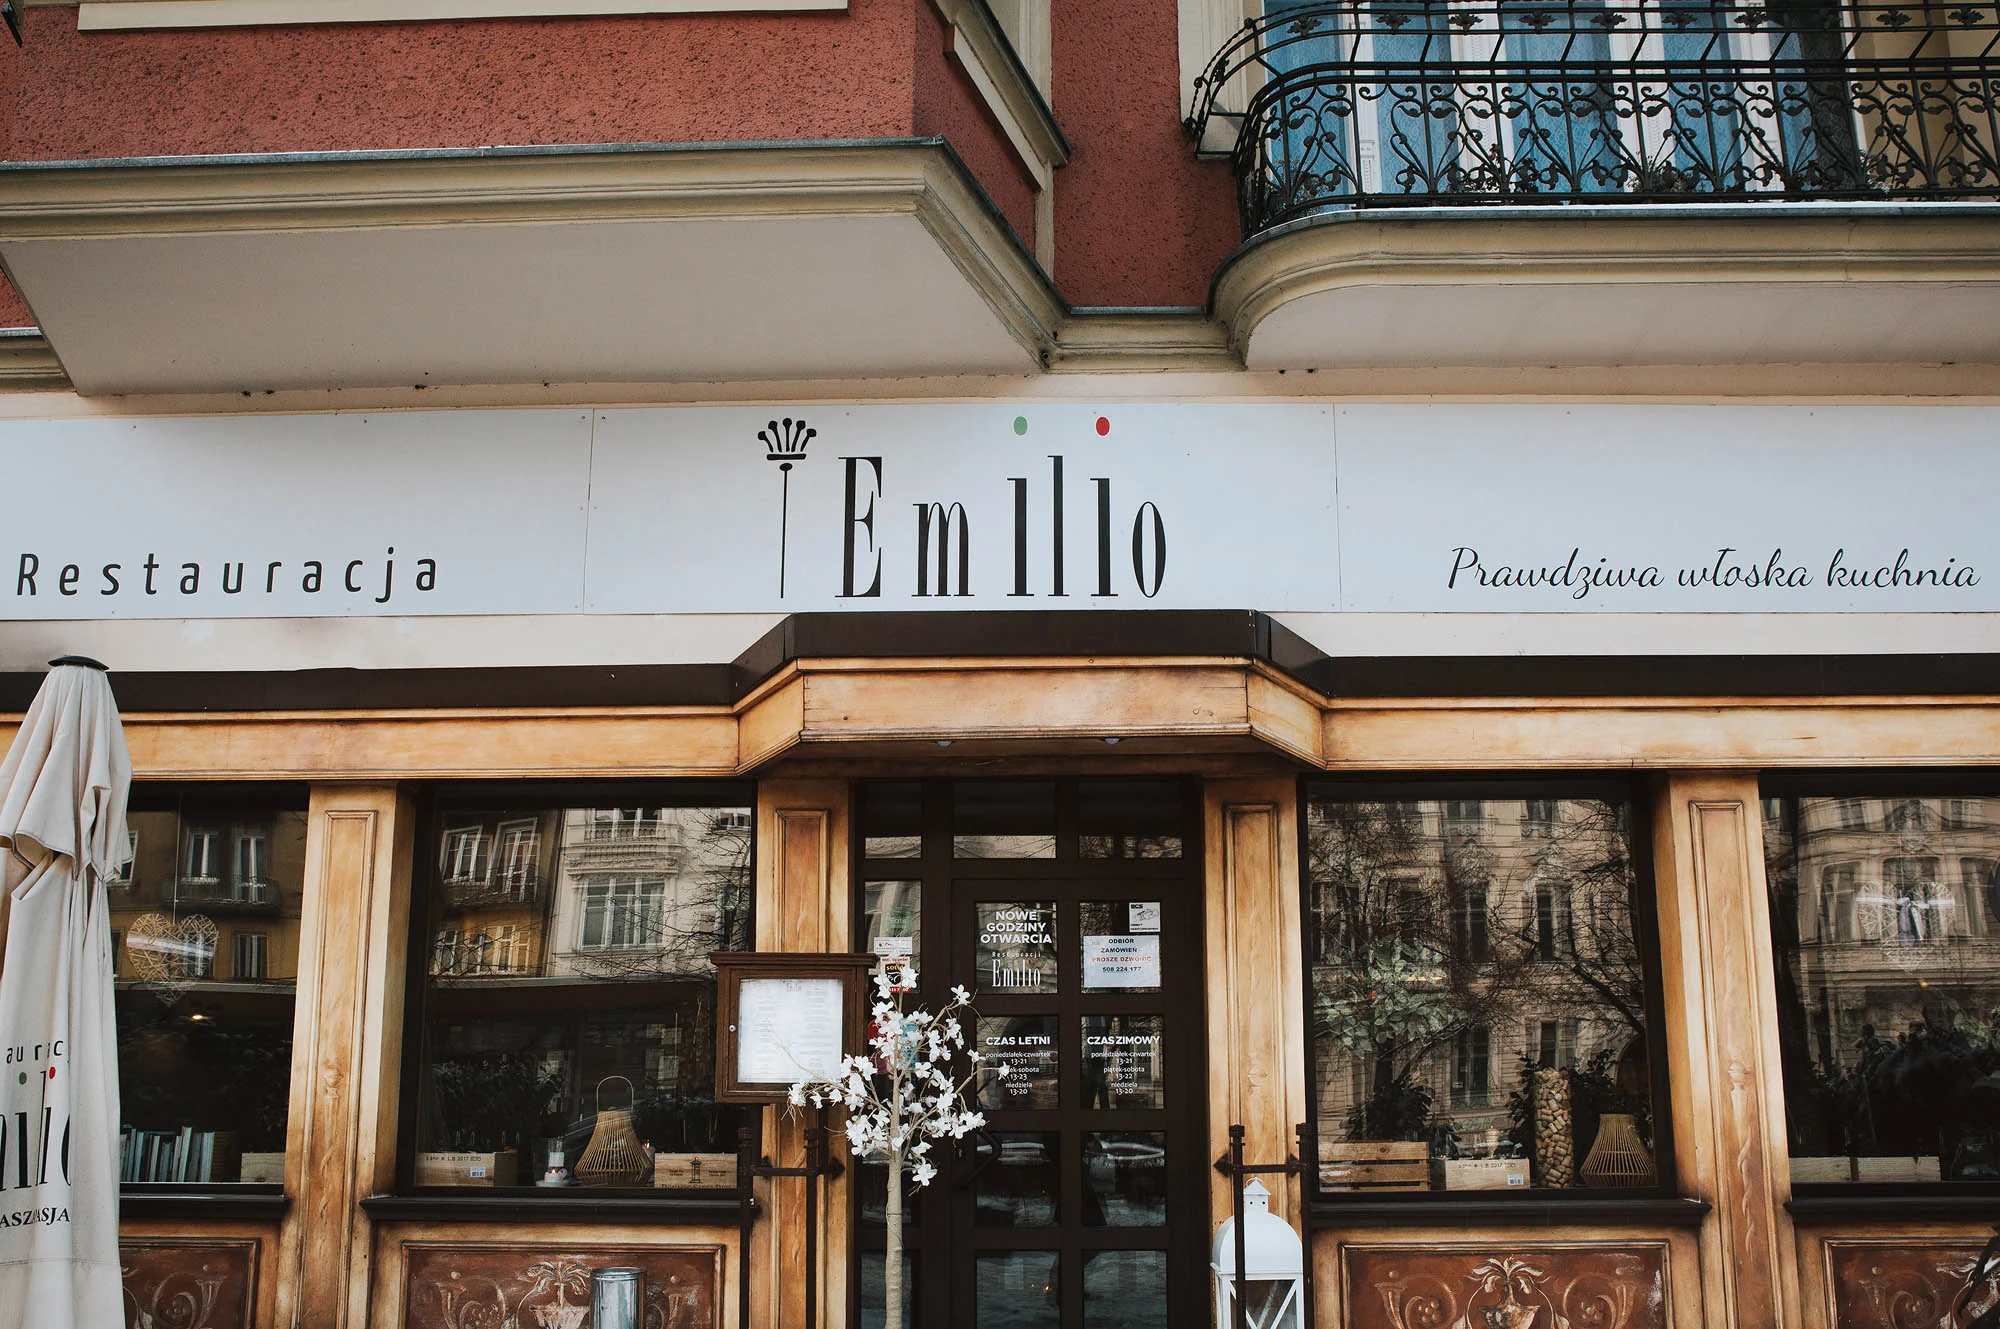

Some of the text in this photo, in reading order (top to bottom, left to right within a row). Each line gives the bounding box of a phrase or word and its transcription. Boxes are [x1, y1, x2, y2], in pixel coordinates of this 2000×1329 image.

[834, 416, 1167, 598] Emilio
[16, 546, 437, 604] Restauracja
[1447, 546, 1983, 600] Prawdziwa włoska kuchnia
[995, 911, 1037, 921] NOWE
[986, 922, 1047, 932] GODZINY
[980, 933, 1052, 944] OTWARCIA
[991, 959, 1041, 987] Emilio
[985, 1036, 1051, 1046] CZAS LETNI
[1086, 1035, 1160, 1045] CZAS ZIMOWY
[1011, 1058, 1027, 1066] 13-21
[1103, 1066, 1145, 1074] piątek-sobota
[1010, 1073, 1028, 1081] 13-23
[1010, 1088, 1028, 1096] 13-20
[1115, 1087, 1134, 1095] 13-20
